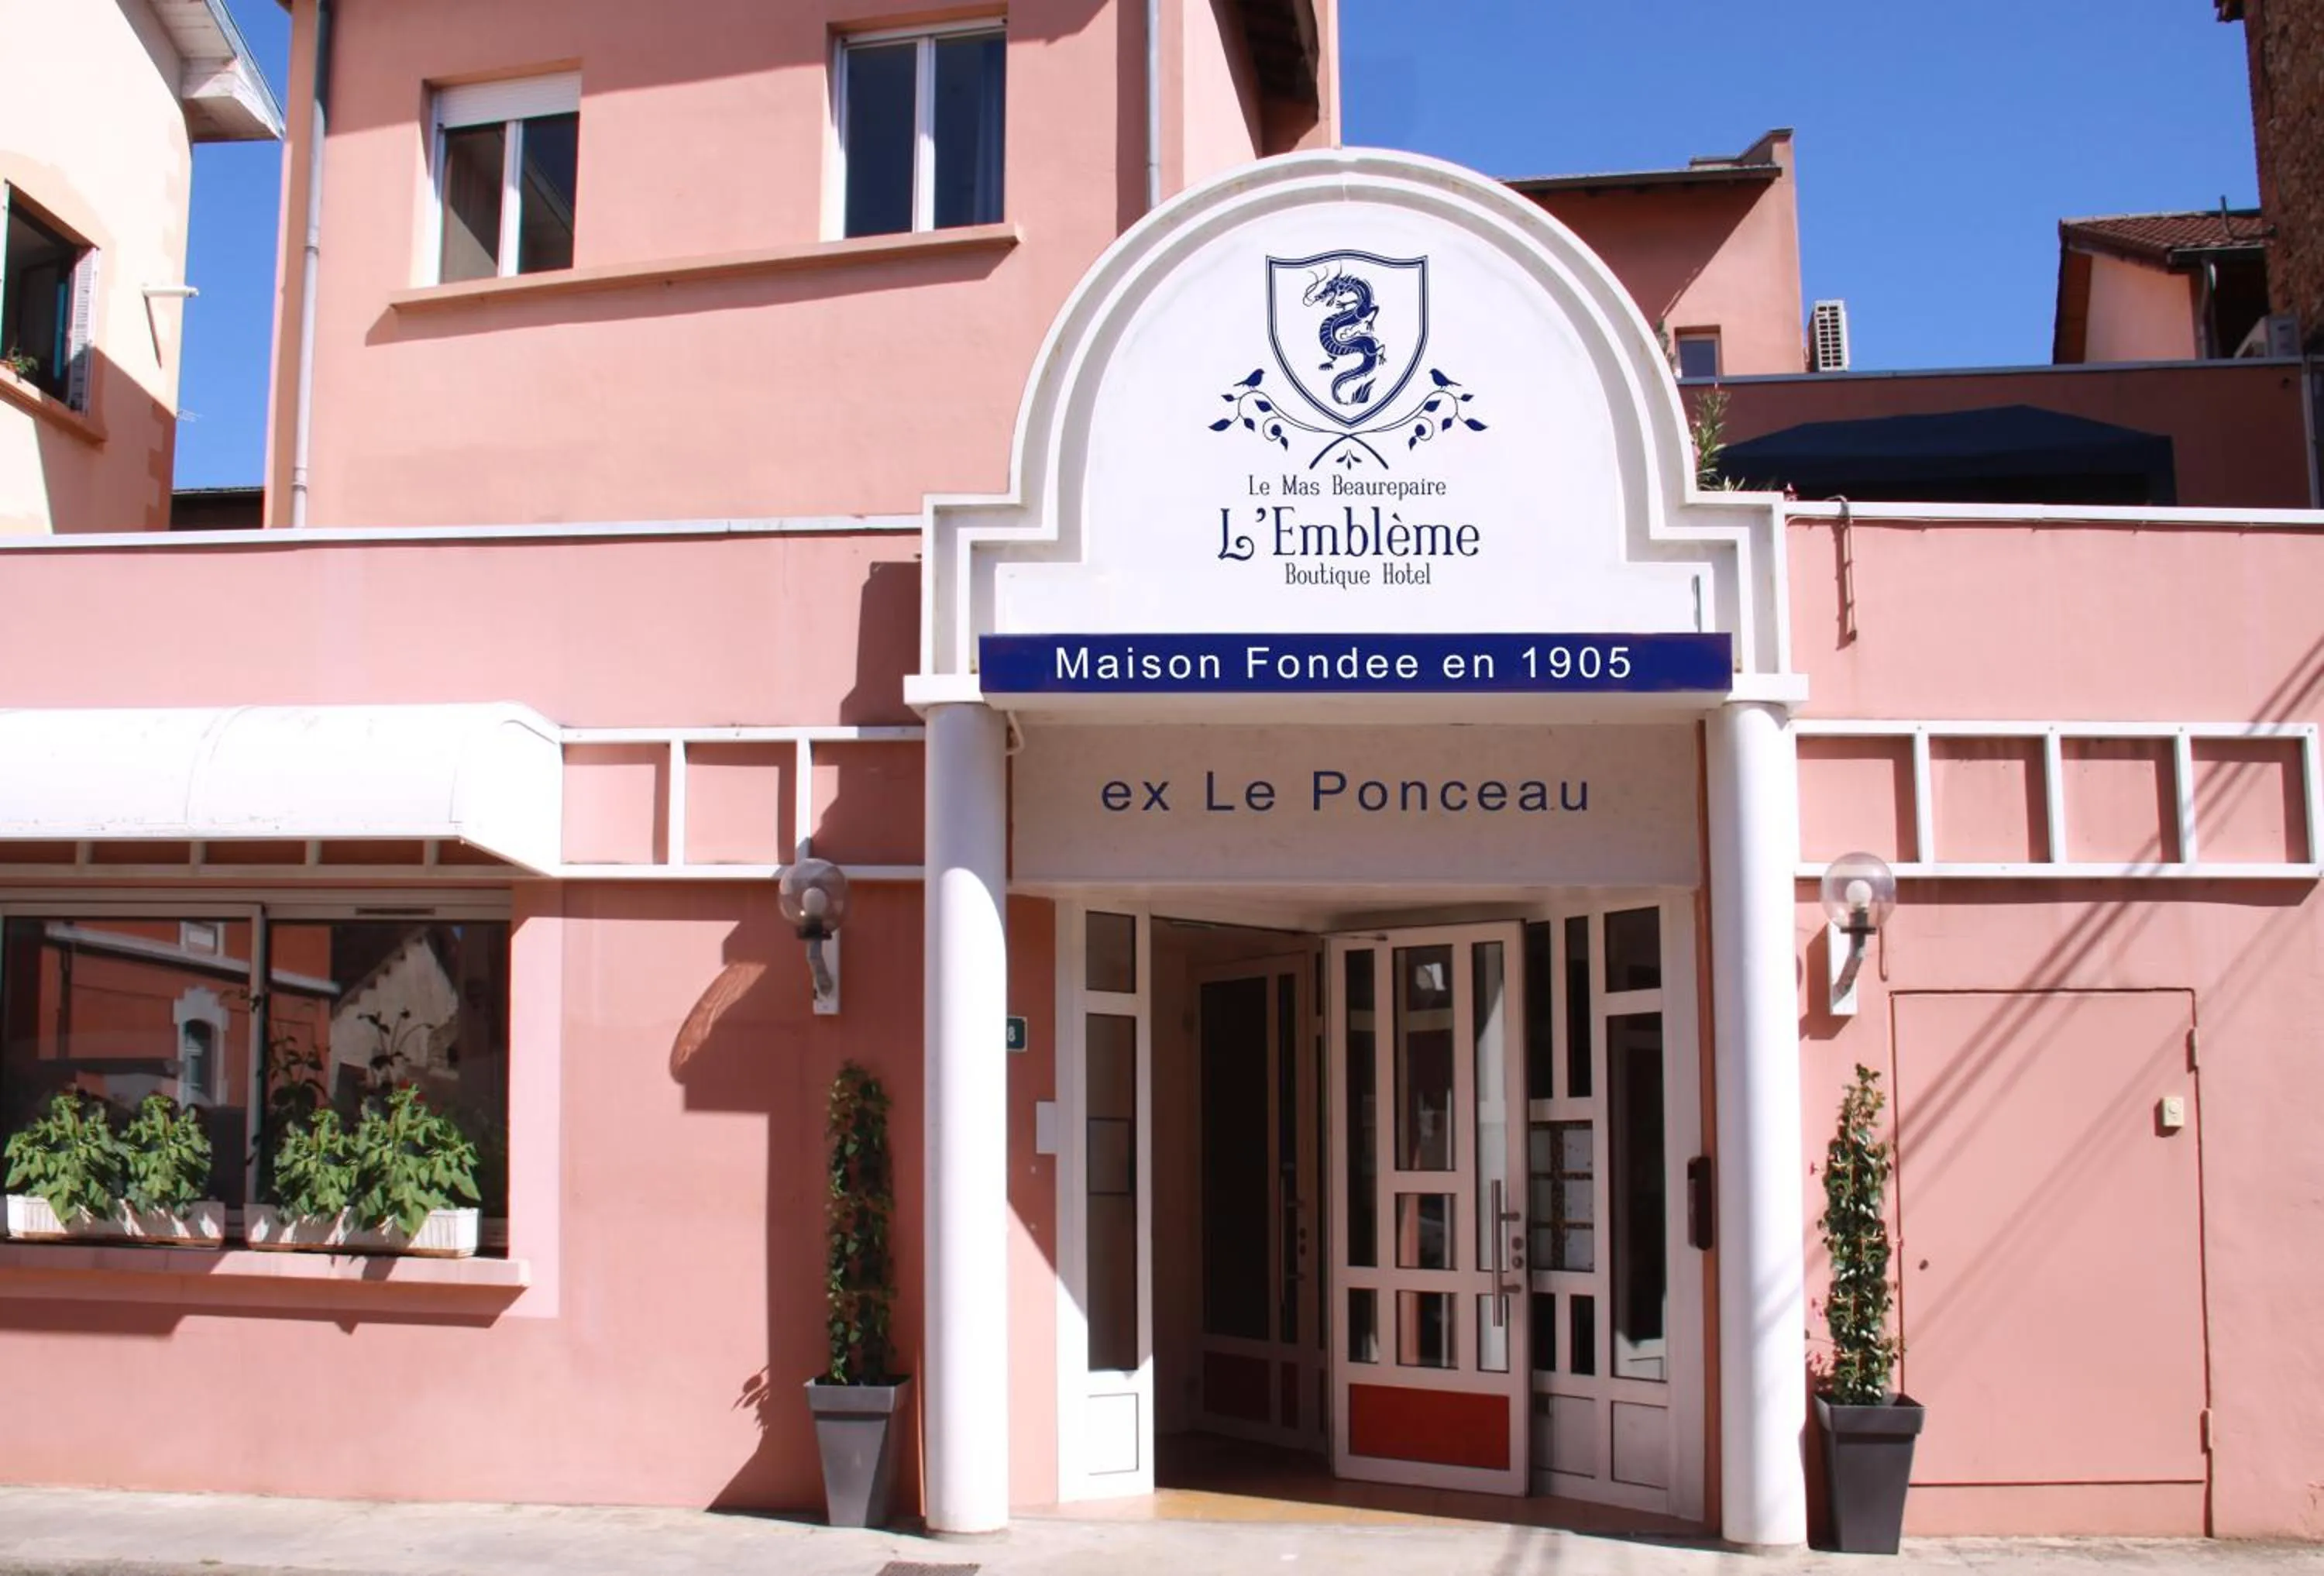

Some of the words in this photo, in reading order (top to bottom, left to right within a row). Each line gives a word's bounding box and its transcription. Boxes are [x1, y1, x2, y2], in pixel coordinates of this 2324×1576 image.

[1249, 474, 1270, 496] Le
[1282, 474, 1320, 496] Mas
[1332, 474, 1446, 501] Beaurepaire
[1217, 506, 1480, 562] L'Emblème
[1285, 563, 1370, 590] Boutique
[1383, 563, 1431, 585] Hotel
[1056, 647, 1220, 680] Maison
[1247, 647, 1418, 679] Fondee
[1442, 655, 1494, 679] en
[1522, 646, 1631, 679] 1905
[1101, 780, 1170, 812] ex
[1206, 771, 1275, 812] Le
[1313, 770, 1590, 812] Ponceau
